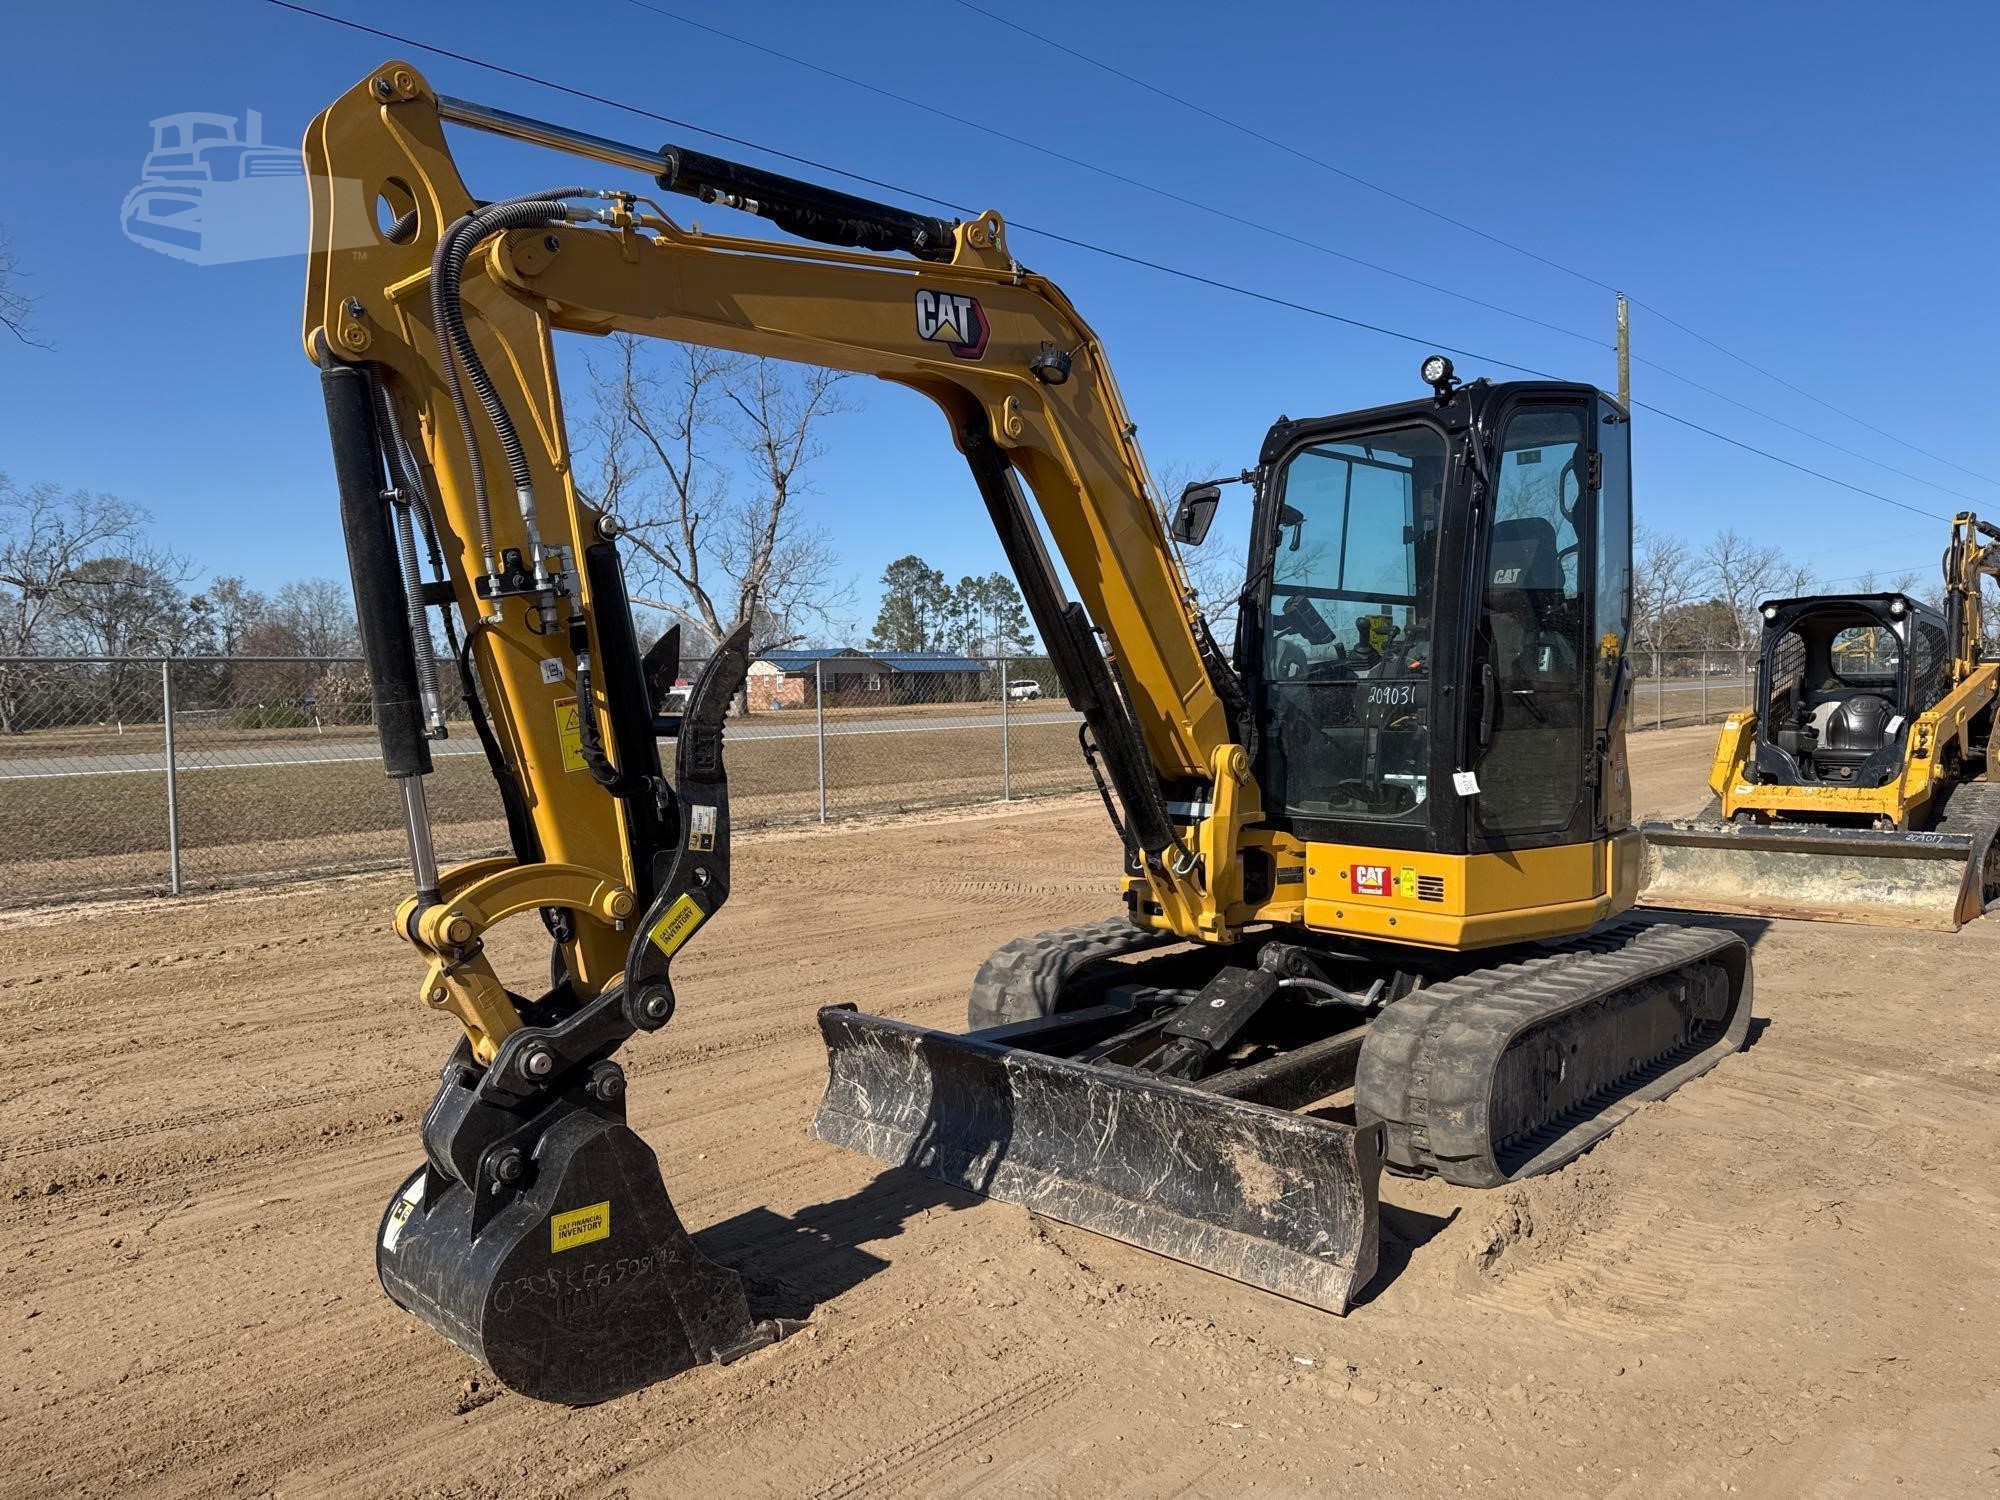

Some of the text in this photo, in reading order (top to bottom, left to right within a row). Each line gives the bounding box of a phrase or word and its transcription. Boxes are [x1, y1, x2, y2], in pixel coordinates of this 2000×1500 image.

[917, 290, 971, 344] CAT
[1493, 568, 1521, 584] CAT
[1367, 686, 1416, 705] 209031
[1906, 834, 1943, 844] 209017
[1357, 866, 1385, 886] CAT
[660, 905, 690, 940] CAT FINANCIAL
[663, 908, 693, 945] INVENTORY
[559, 1214, 602, 1232] CAT FINANCIAL
[559, 1221, 602, 1239] INVENTORY
